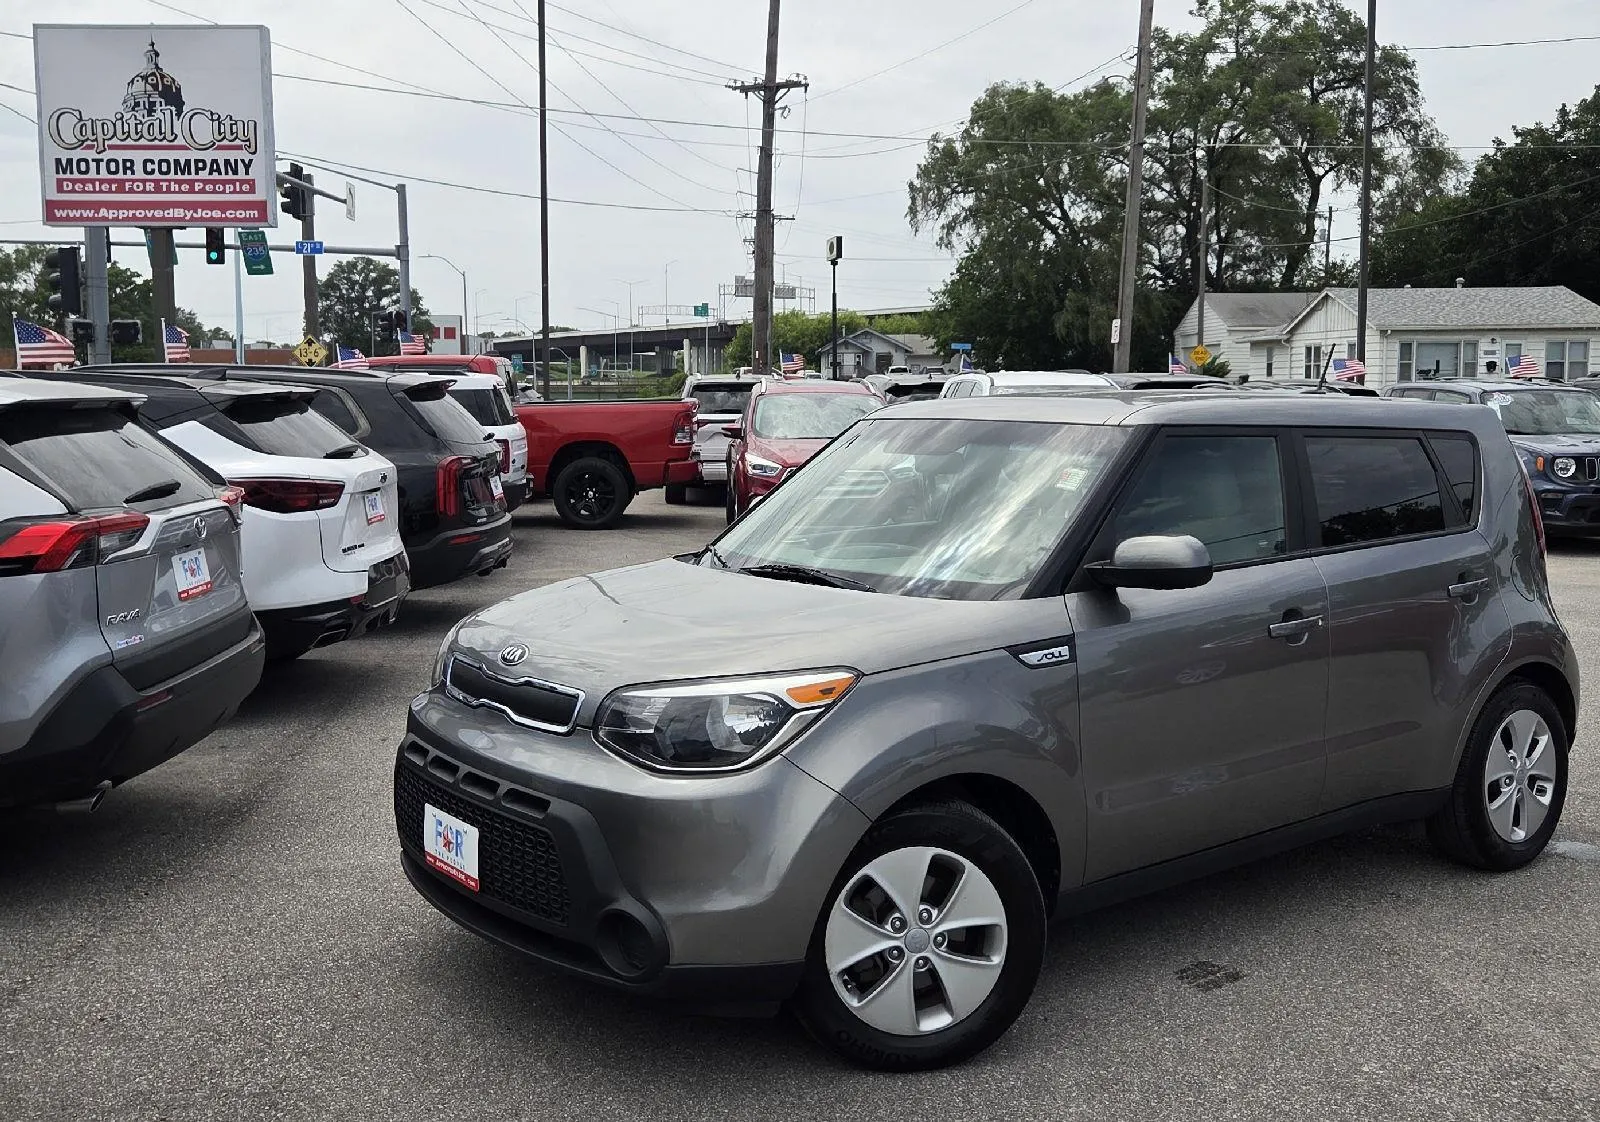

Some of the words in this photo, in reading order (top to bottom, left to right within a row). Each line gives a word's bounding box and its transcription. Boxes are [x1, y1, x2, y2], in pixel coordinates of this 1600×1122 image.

[49, 107, 178, 154] Capital
[181, 108, 257, 155] City
[55, 158, 136, 176] MOTOR
[142, 158, 254, 176] COMPANY
[62, 181, 118, 192] Dealer
[125, 181, 155, 192] FOR
[160, 181, 190, 192] The
[194, 181, 251, 194] People
[54, 207, 259, 220] www.ApprovedByJoe.com
[241, 233, 263, 241] EAST
[246, 246, 265, 256] 235
[503, 647, 522, 661] KIA
[435, 818, 464, 860] FOR
